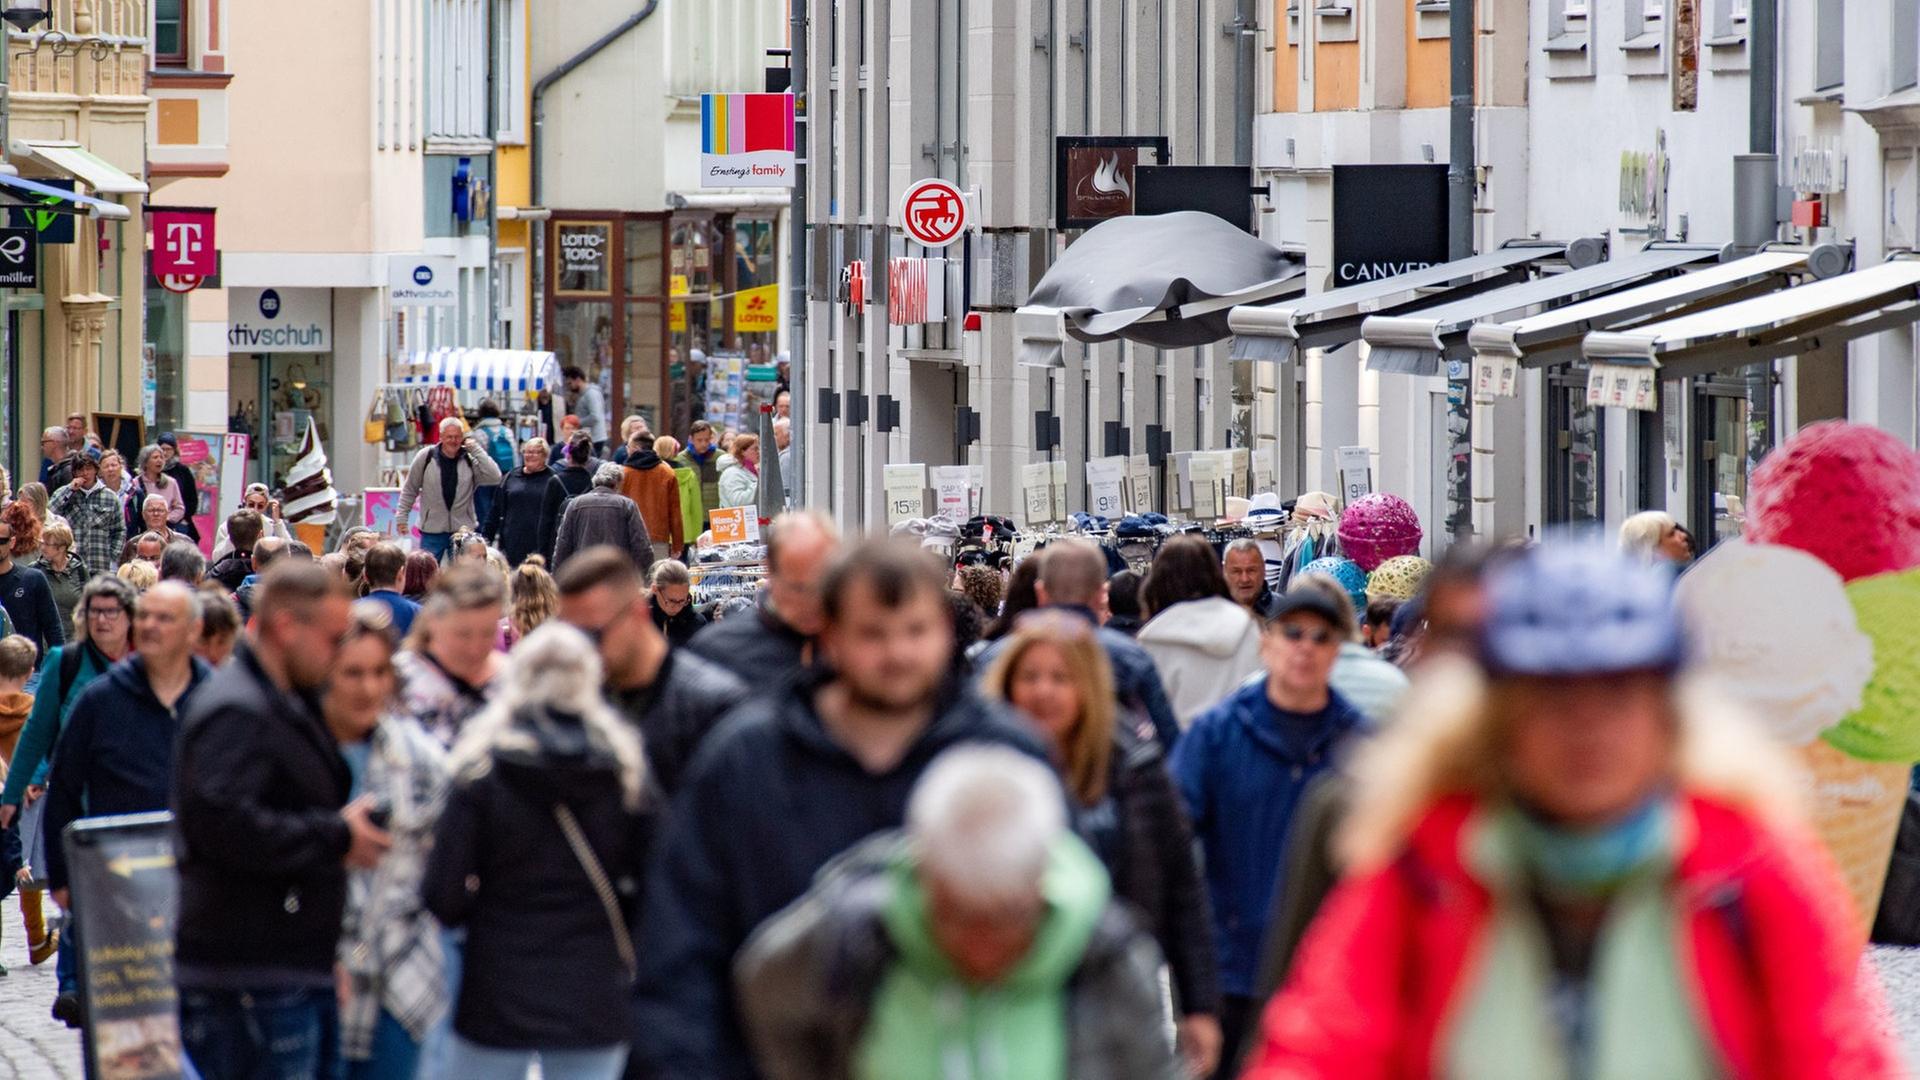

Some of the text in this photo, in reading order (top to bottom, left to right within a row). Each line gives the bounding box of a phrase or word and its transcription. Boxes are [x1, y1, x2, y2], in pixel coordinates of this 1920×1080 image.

[709, 164, 786, 179] Ernsting's family
[166, 223, 202, 265] T
[1339, 262, 1444, 281] CANVE
[392, 289, 454, 299] aktivschuh
[738, 314, 774, 324] LOTTO
